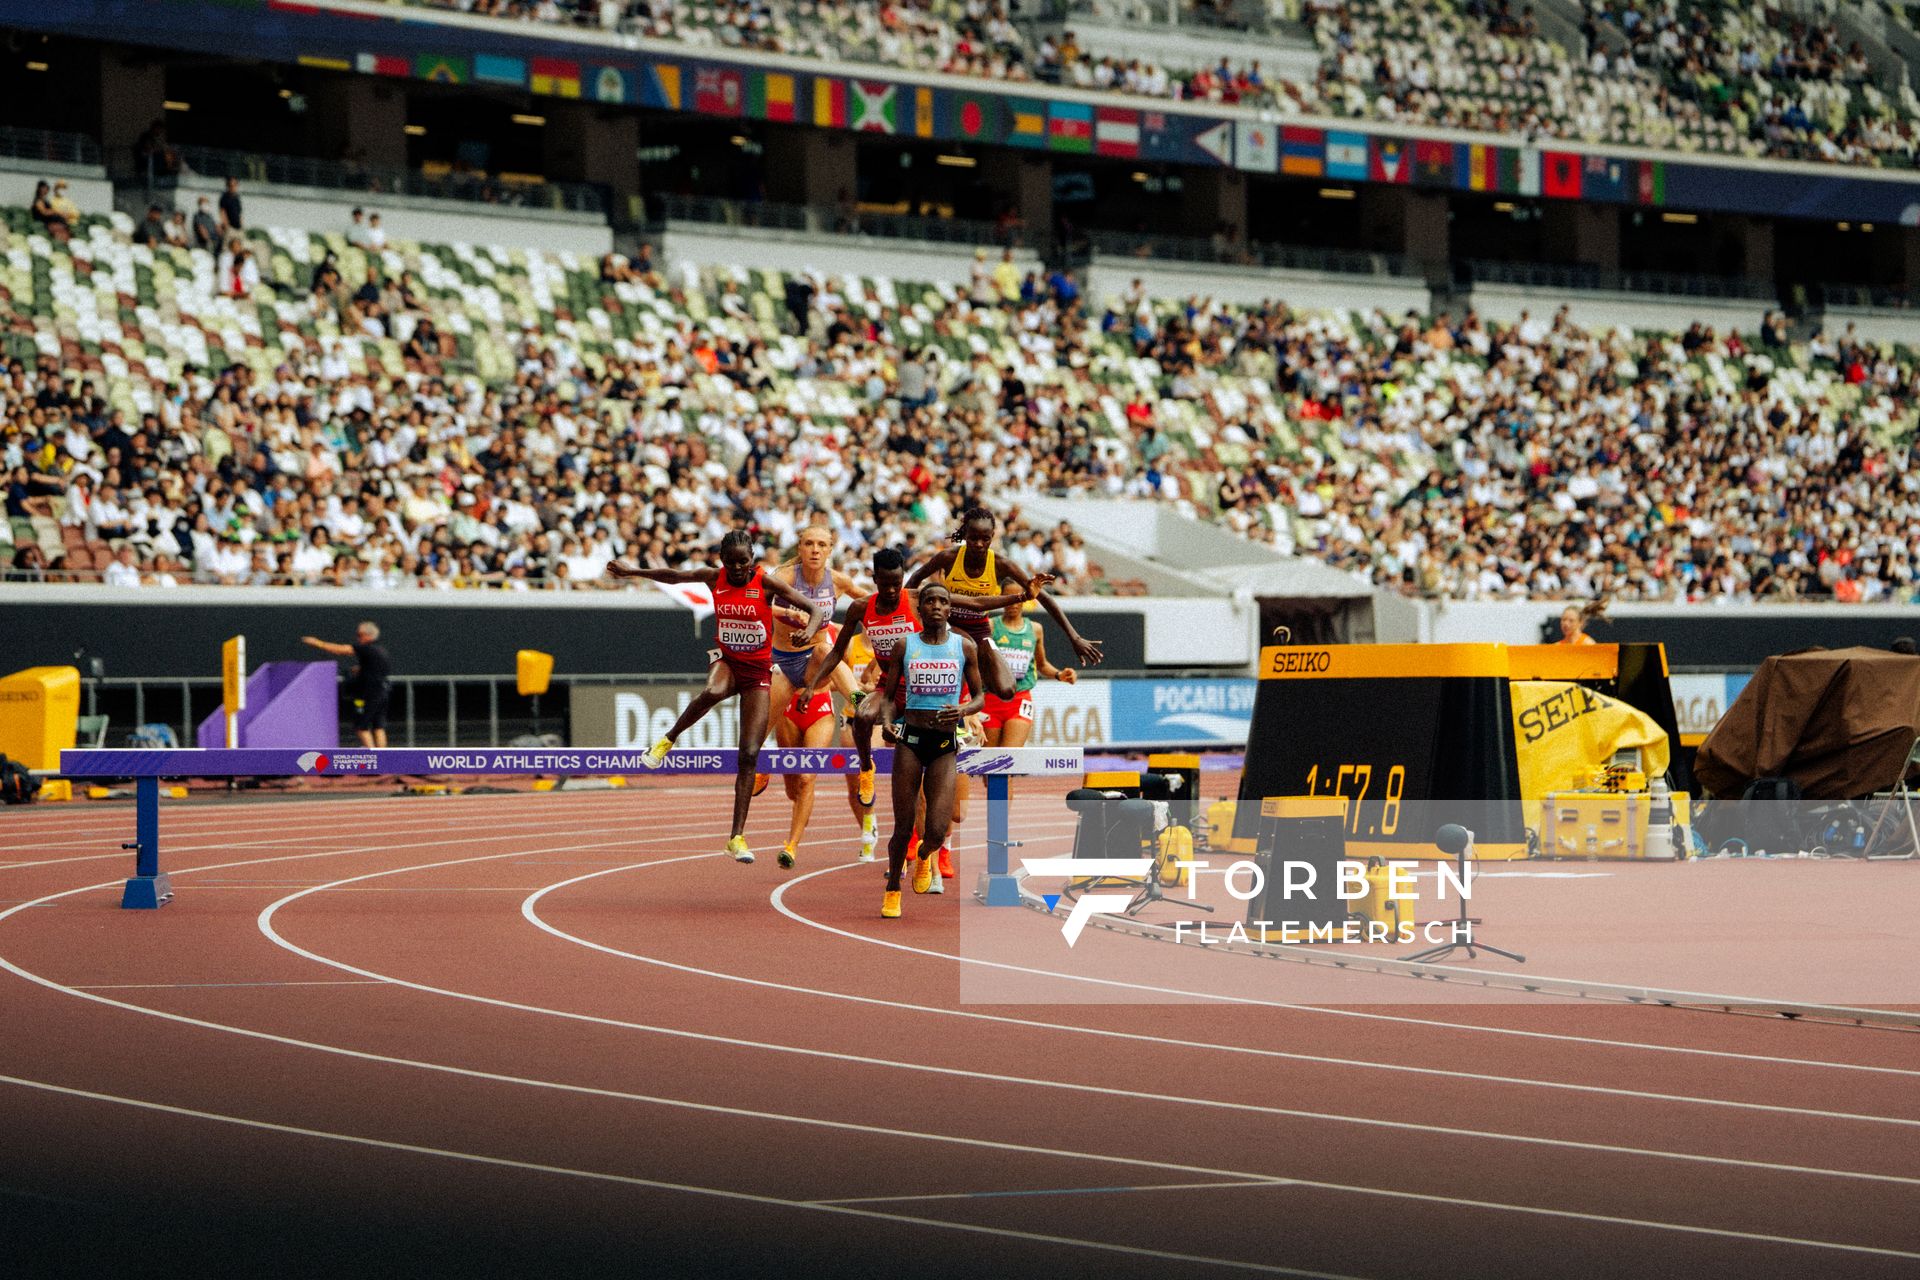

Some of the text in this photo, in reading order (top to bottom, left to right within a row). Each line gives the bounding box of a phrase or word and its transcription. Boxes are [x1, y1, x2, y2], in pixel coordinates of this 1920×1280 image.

[717, 604, 757, 616] KENYA
[720, 622, 763, 630] HONDA
[868, 626, 912, 636] HONDA
[722, 632, 763, 643] BIWOT
[1273, 651, 1331, 673] SEIKO
[912, 674, 956, 685] JERUTO
[1154, 685, 1226, 712] POCARI
[1518, 684, 1613, 744] SEIK
[428, 756, 722, 769] WORLD ATHLETICS CHAMPONSHIPS
[1046, 759, 1078, 768] NISHI
